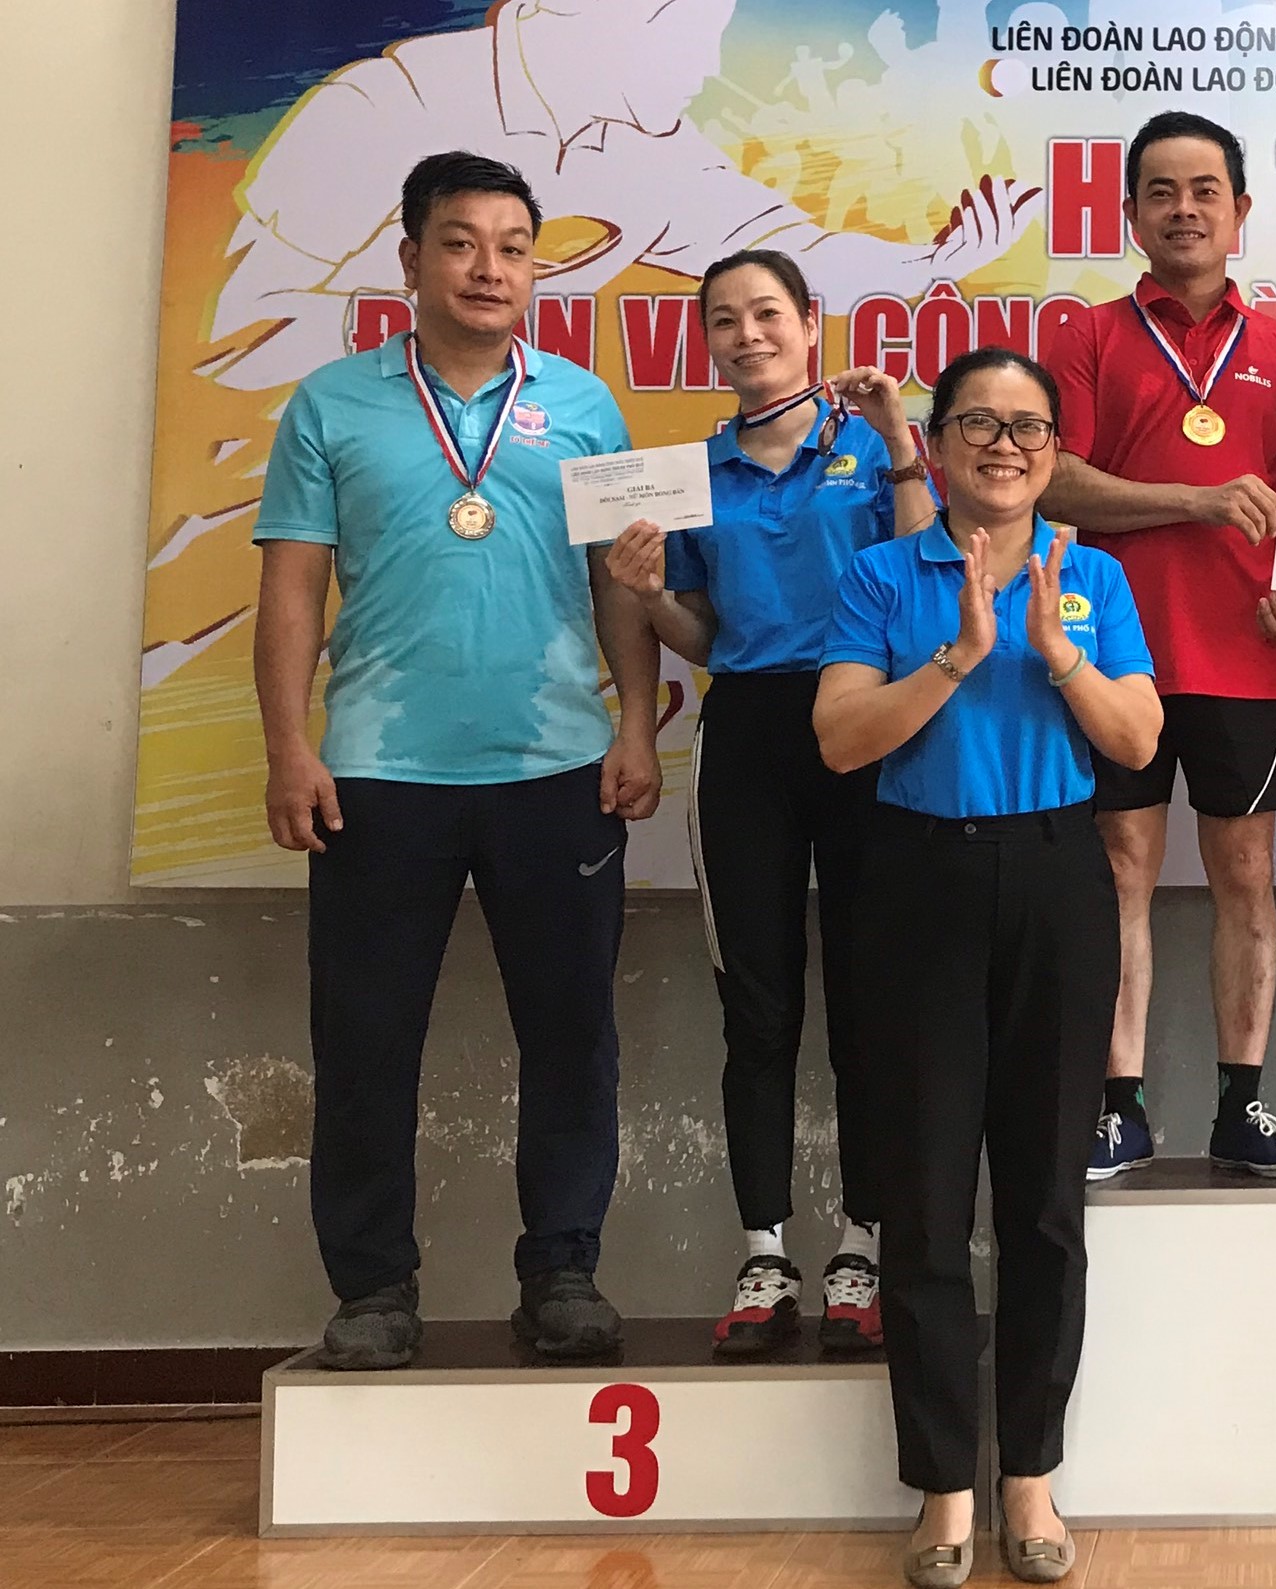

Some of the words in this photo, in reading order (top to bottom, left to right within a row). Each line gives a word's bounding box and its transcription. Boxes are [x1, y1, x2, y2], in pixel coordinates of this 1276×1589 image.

[991, 20, 1053, 51] LIÊN
[1061, 20, 1143, 51] ĐOÀN
[1153, 26, 1206, 51] LAO
[1031, 60, 1093, 91] LIÊN
[1101, 60, 1183, 91] ĐOÀN
[1192, 66, 1246, 91] LAO
[1234, 372, 1272, 388] NOBILIS
[586, 1383, 659, 1517] 3
